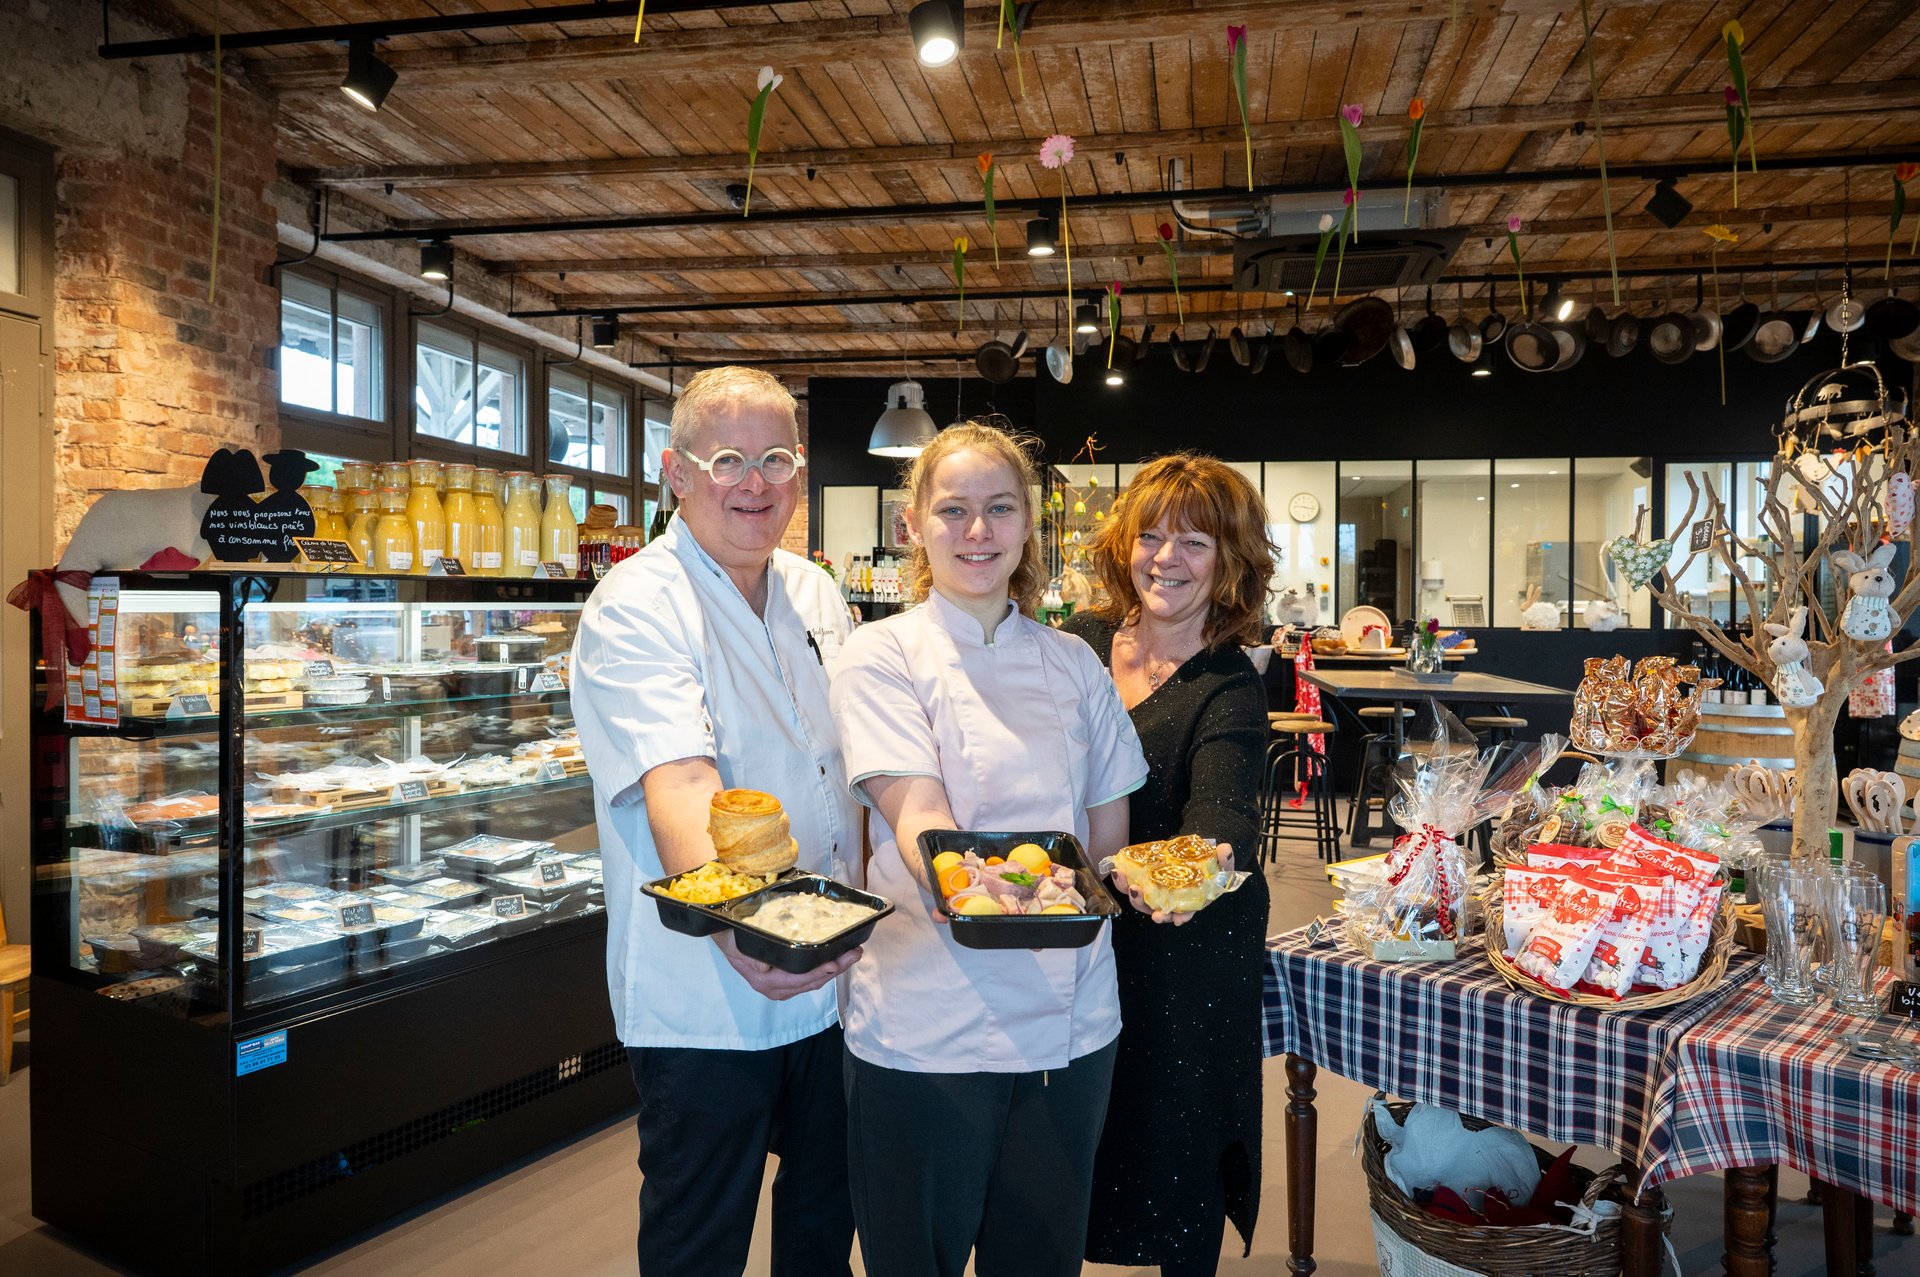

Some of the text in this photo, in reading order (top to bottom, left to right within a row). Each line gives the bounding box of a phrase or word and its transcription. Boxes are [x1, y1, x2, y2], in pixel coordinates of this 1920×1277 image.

[210, 510, 228, 518] Nous
[254, 511, 292, 521] proposons
[295, 508, 311, 516] tous
[229, 521, 248, 529] vins
[249, 520, 278, 530] blancs
